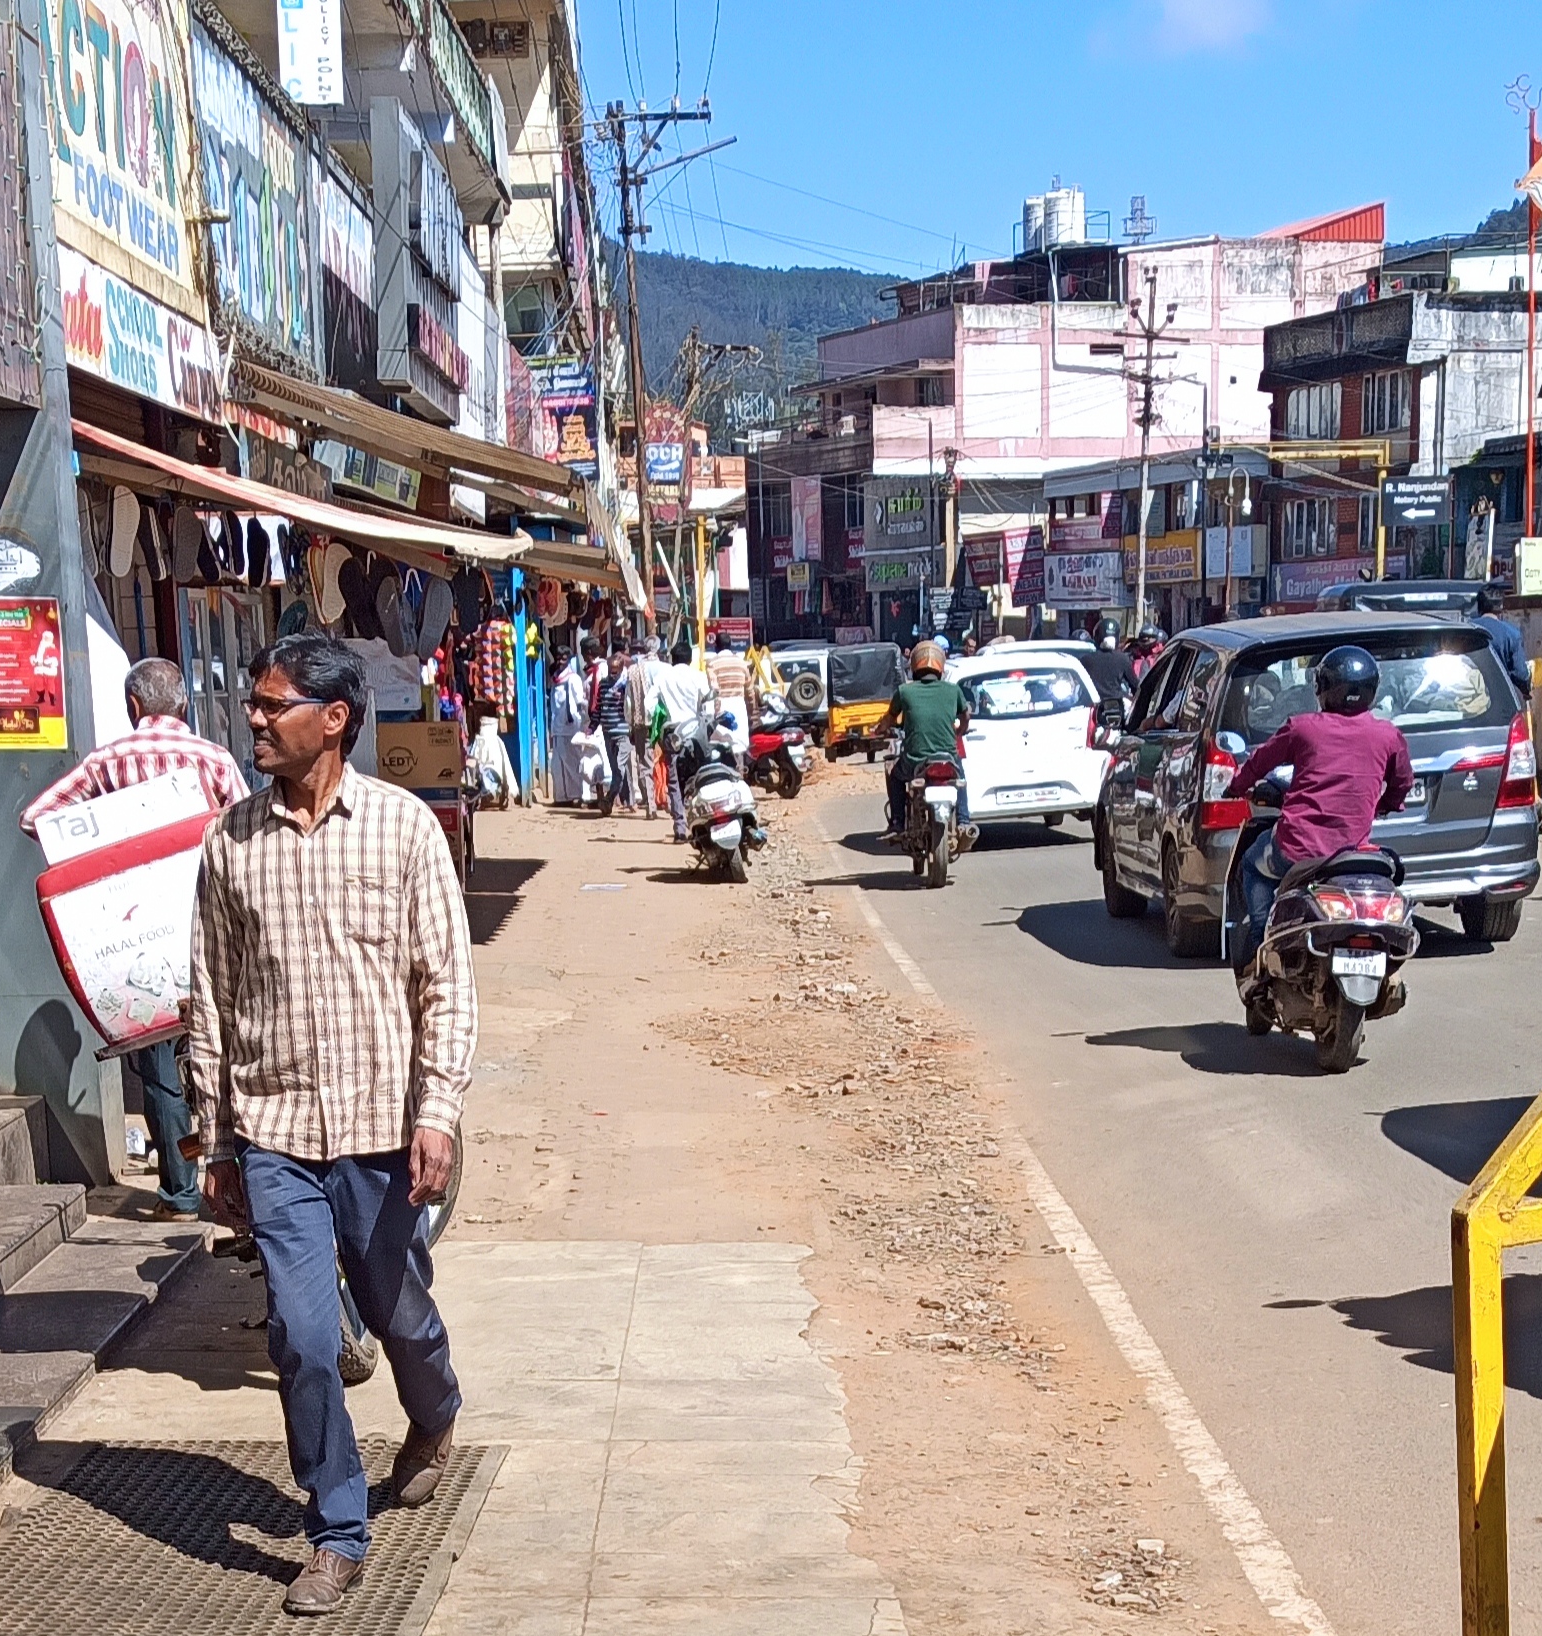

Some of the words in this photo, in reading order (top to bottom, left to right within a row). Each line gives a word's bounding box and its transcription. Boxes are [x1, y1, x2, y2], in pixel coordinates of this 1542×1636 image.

[284, 11, 303, 101] LIC
[73, 151, 124, 234] FOOT
[125, 187, 180, 275] WEAR
[105, 278, 162, 349] SCHOOL
[109, 335, 158, 396] SHOES
[1385, 483, 1396, 493] R.
[1397, 481, 1449, 494] Nanjundan
[1394, 495, 1419, 505] Notary
[1419, 494, 1442, 504] Public
[46, 806, 100, 842] Taj
[94, 935, 137, 961] HALAL
[138, 923, 175, 946] FOOD
